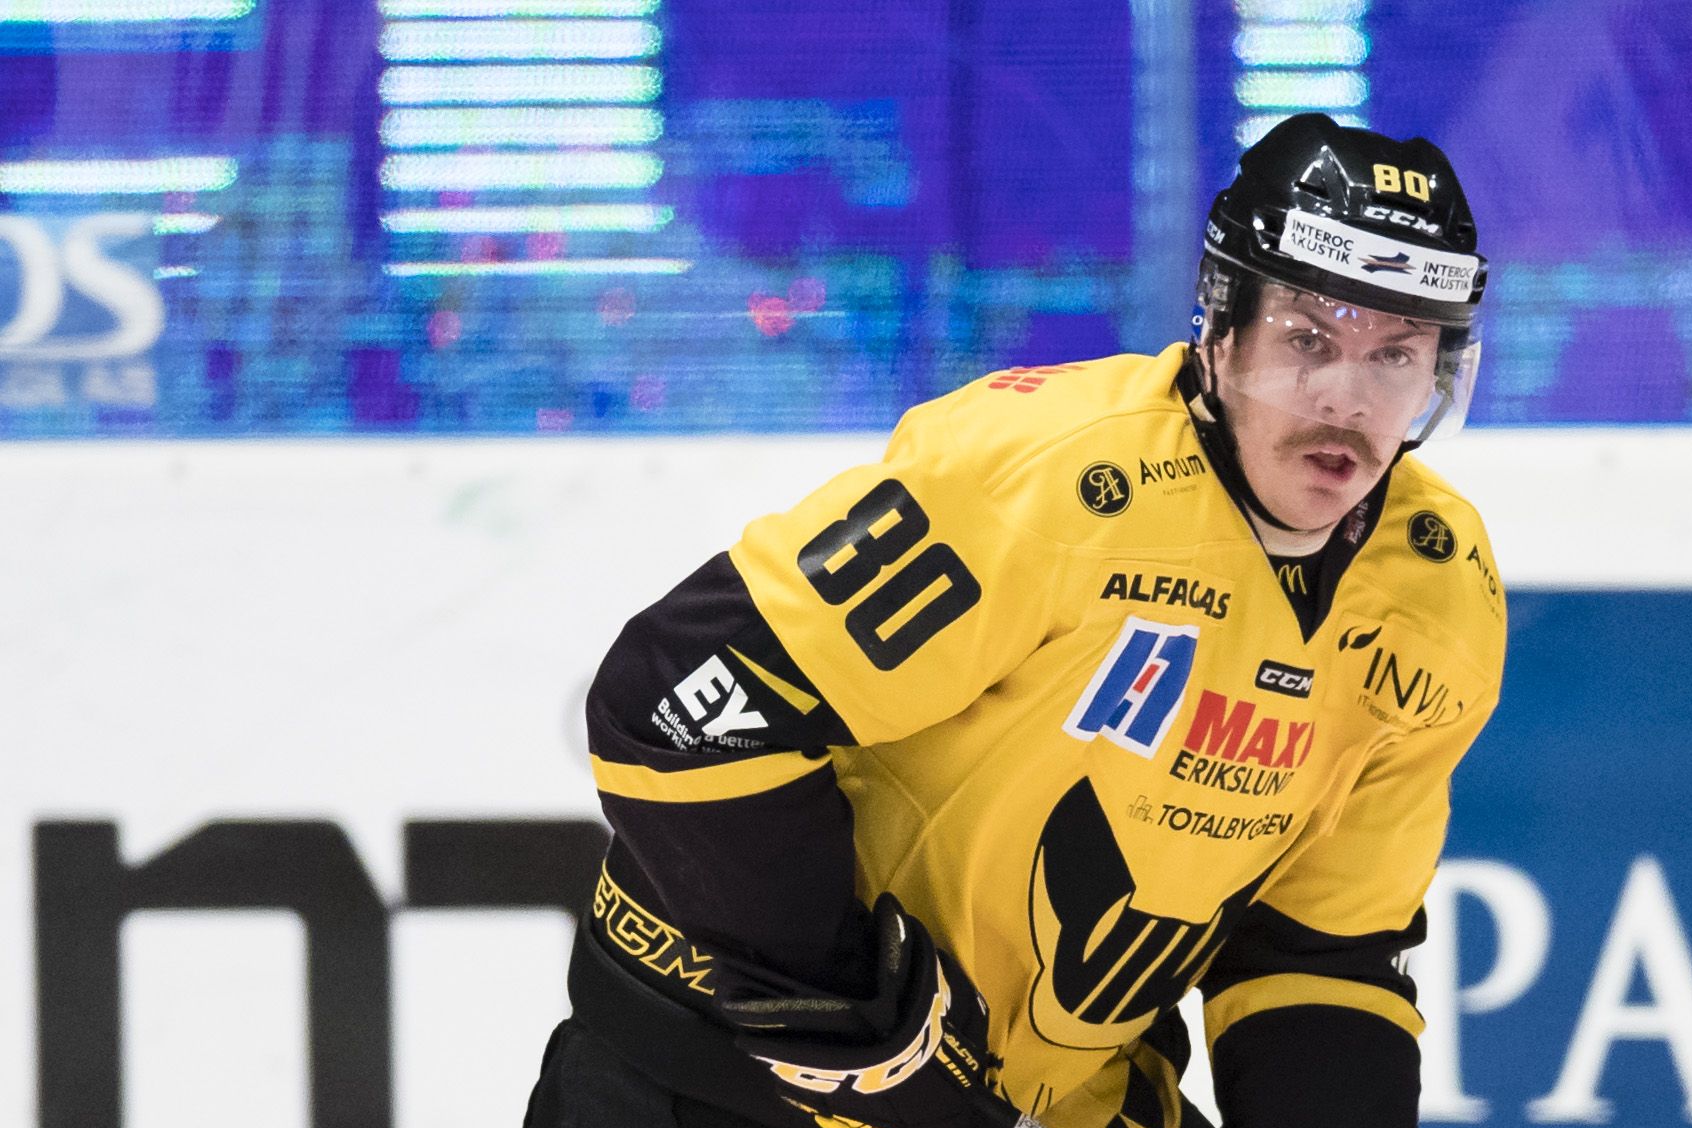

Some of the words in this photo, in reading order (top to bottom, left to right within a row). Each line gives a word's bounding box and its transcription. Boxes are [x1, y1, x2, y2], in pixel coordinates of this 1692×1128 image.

[1373, 164, 1430, 202] 80
[1292, 219, 1354, 251] INTEROC
[1364, 206, 1440, 234] CCM
[1291, 232, 1351, 265] AKUSTIK
[1420, 275, 1469, 290] AKUSTIK
[1423, 261, 1474, 279] INTEROC
[797, 478, 983, 672] 80
[674, 655, 768, 736] EY
[1260, 667, 1313, 692] CCM
